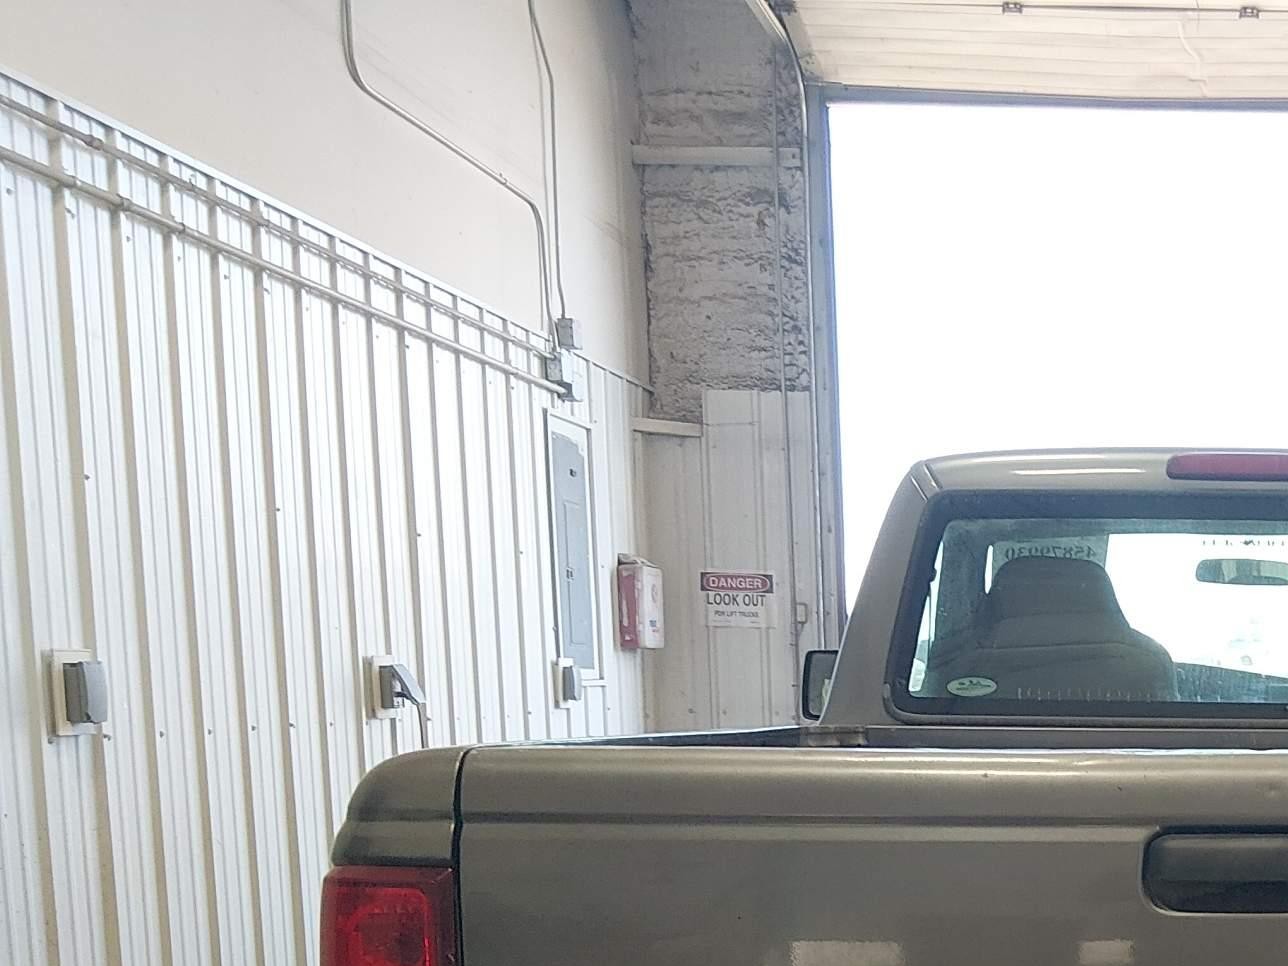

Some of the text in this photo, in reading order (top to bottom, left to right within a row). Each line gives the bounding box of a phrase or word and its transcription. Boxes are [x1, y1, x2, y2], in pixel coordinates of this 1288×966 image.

[709, 577, 762, 588] DANGER
[706, 592, 766, 607] LOOK OUT
